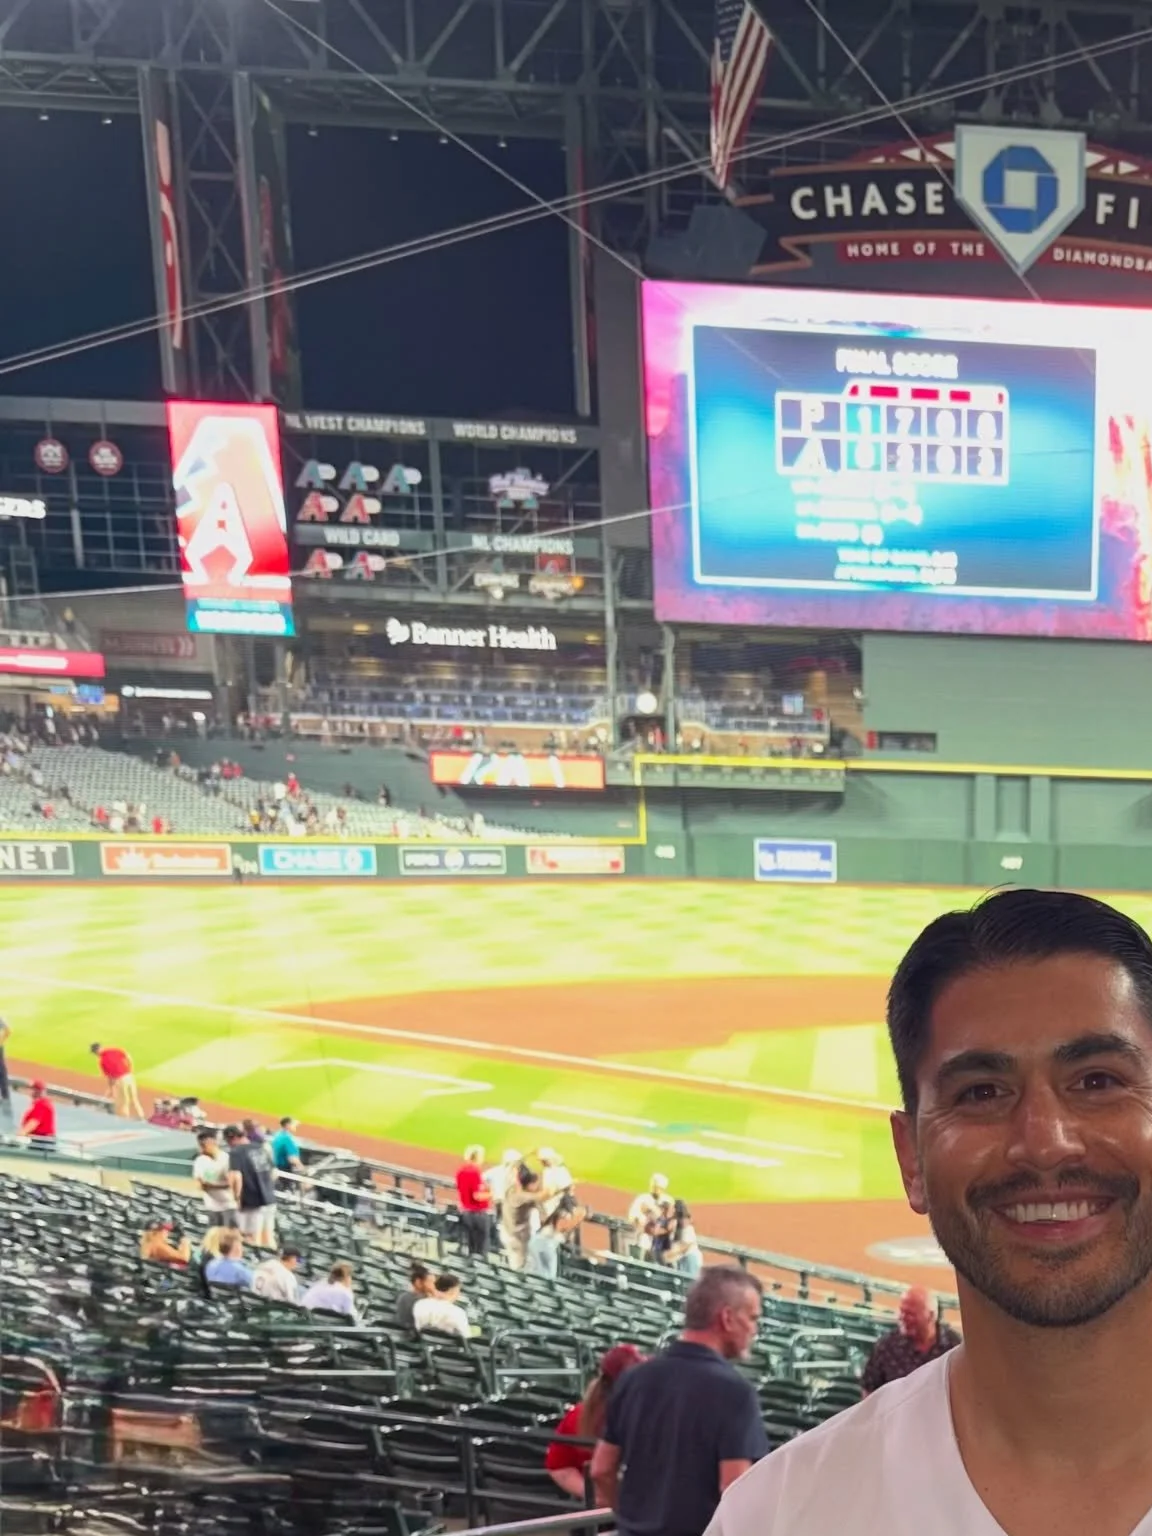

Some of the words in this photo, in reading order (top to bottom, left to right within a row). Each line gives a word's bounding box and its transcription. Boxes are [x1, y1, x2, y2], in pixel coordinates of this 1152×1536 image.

[791, 182, 945, 220] CHASE
[846, 241, 901, 259] HOME
[912, 242, 937, 258] OF
[950, 241, 985, 258] THE
[305, 414, 343, 431] WEST
[347, 416, 426, 436] CHAMPIONS
[453, 422, 499, 440] WORLD
[501, 424, 577, 445] CHAMPIONS
[411, 622, 486, 648] Banner
[488, 625, 557, 651] Health
